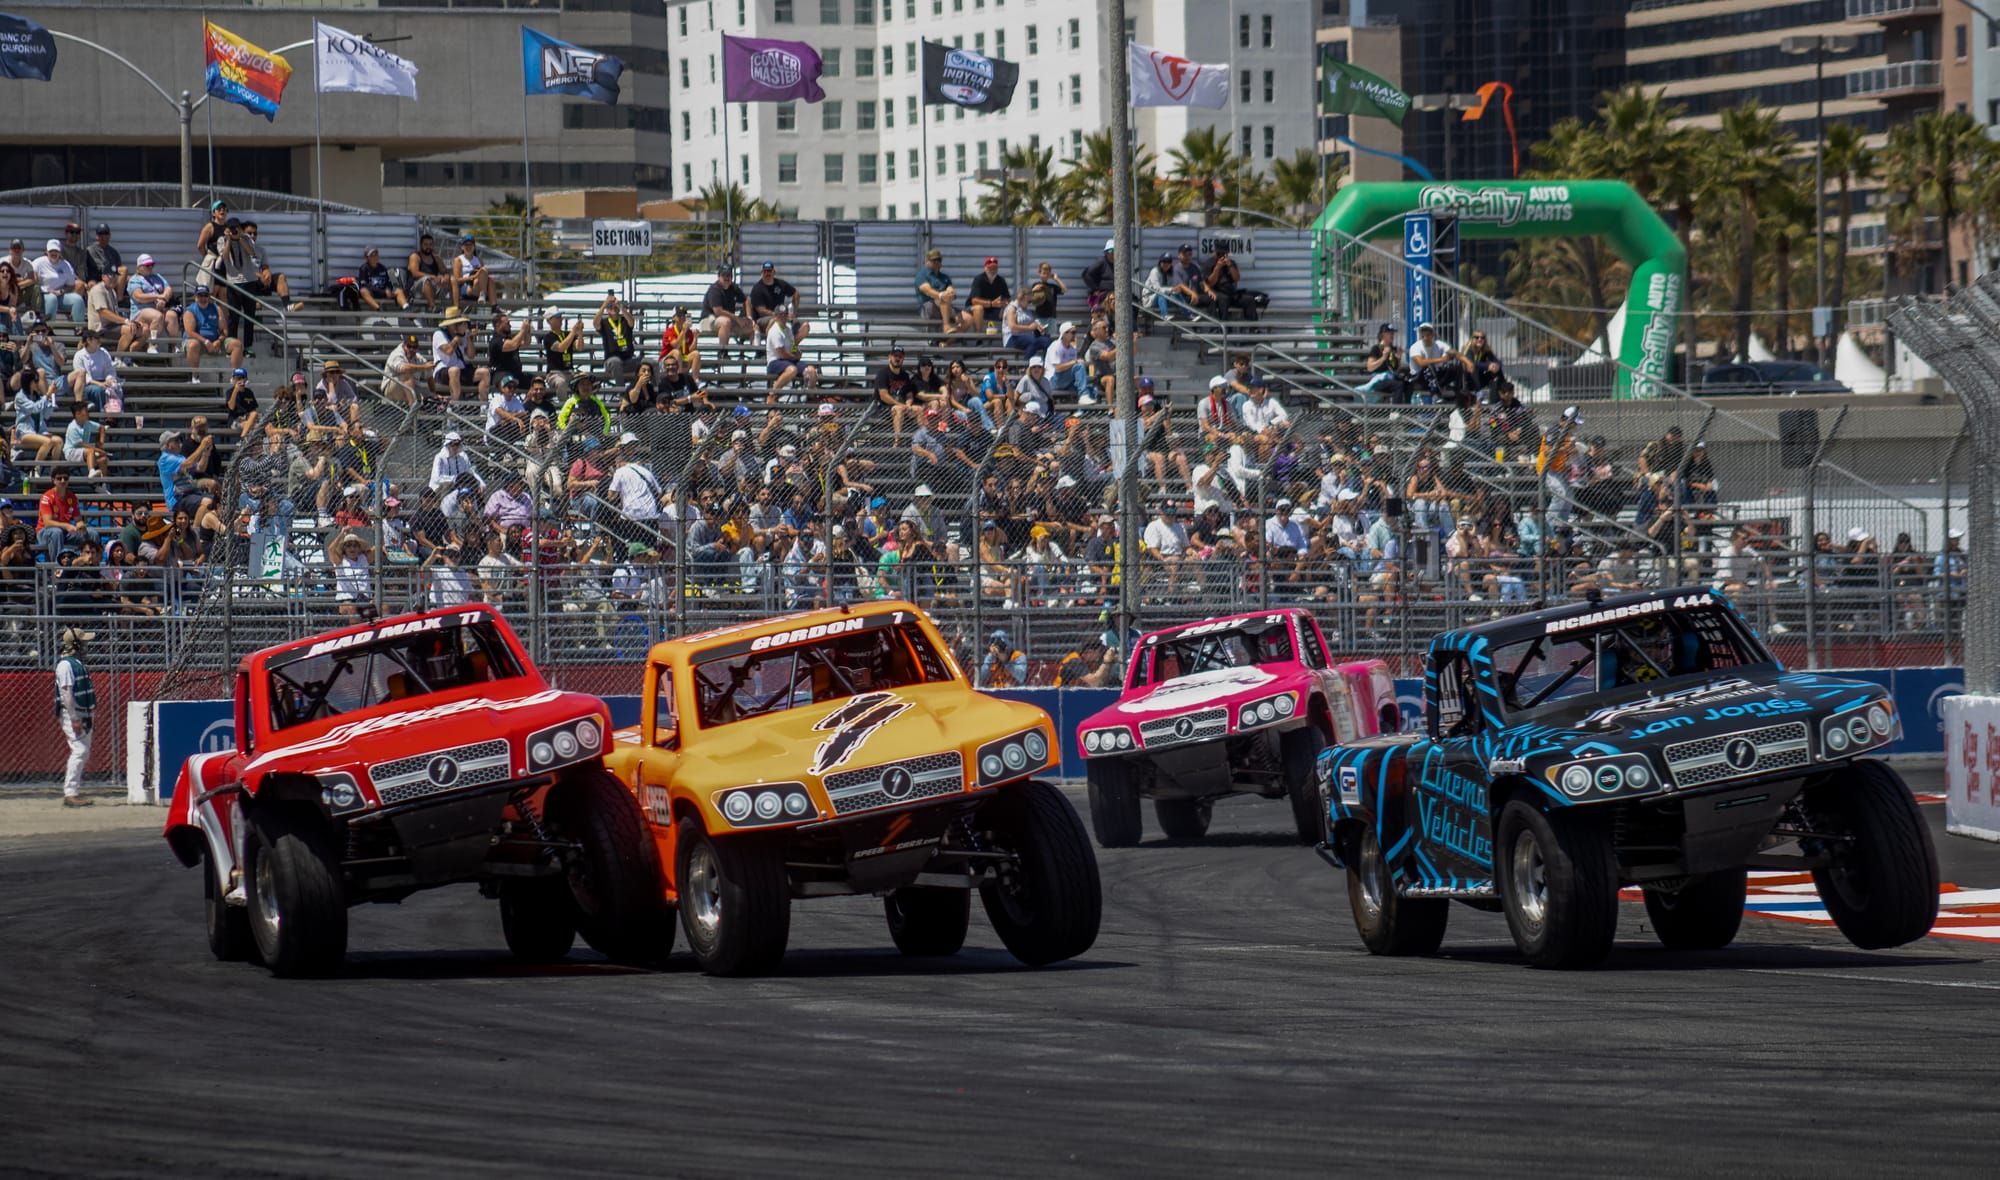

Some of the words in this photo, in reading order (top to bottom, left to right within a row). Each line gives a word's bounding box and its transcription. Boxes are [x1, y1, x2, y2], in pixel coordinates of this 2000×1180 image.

[20, 33, 33, 43] OF
[1, 43, 47, 55] CALIFORNIA
[753, 51, 798, 71] COOLER
[753, 66, 798, 85] MASTER
[943, 67, 993, 88] INDYCAR
[1529, 186, 1570, 202] AUTO
[1526, 204, 1573, 222] PARTS
[595, 229, 642, 247] SECTION
[643, 229, 650, 247] 3
[1245, 238, 1252, 254] 4
[1648, 272, 1667, 310] AUTO
[1663, 272, 1681, 314] PARTS
[1265, 614, 1283, 625] 21
[1545, 599, 1666, 634] RICHARDSON
[1673, 593, 1714, 609] 444
[306, 630, 375, 658] MAD
[378, 616, 443, 639] MAX
[750, 617, 865, 651] GORDON
[1628, 714, 1696, 740] Jan
[1703, 698, 1810, 721] Jones
